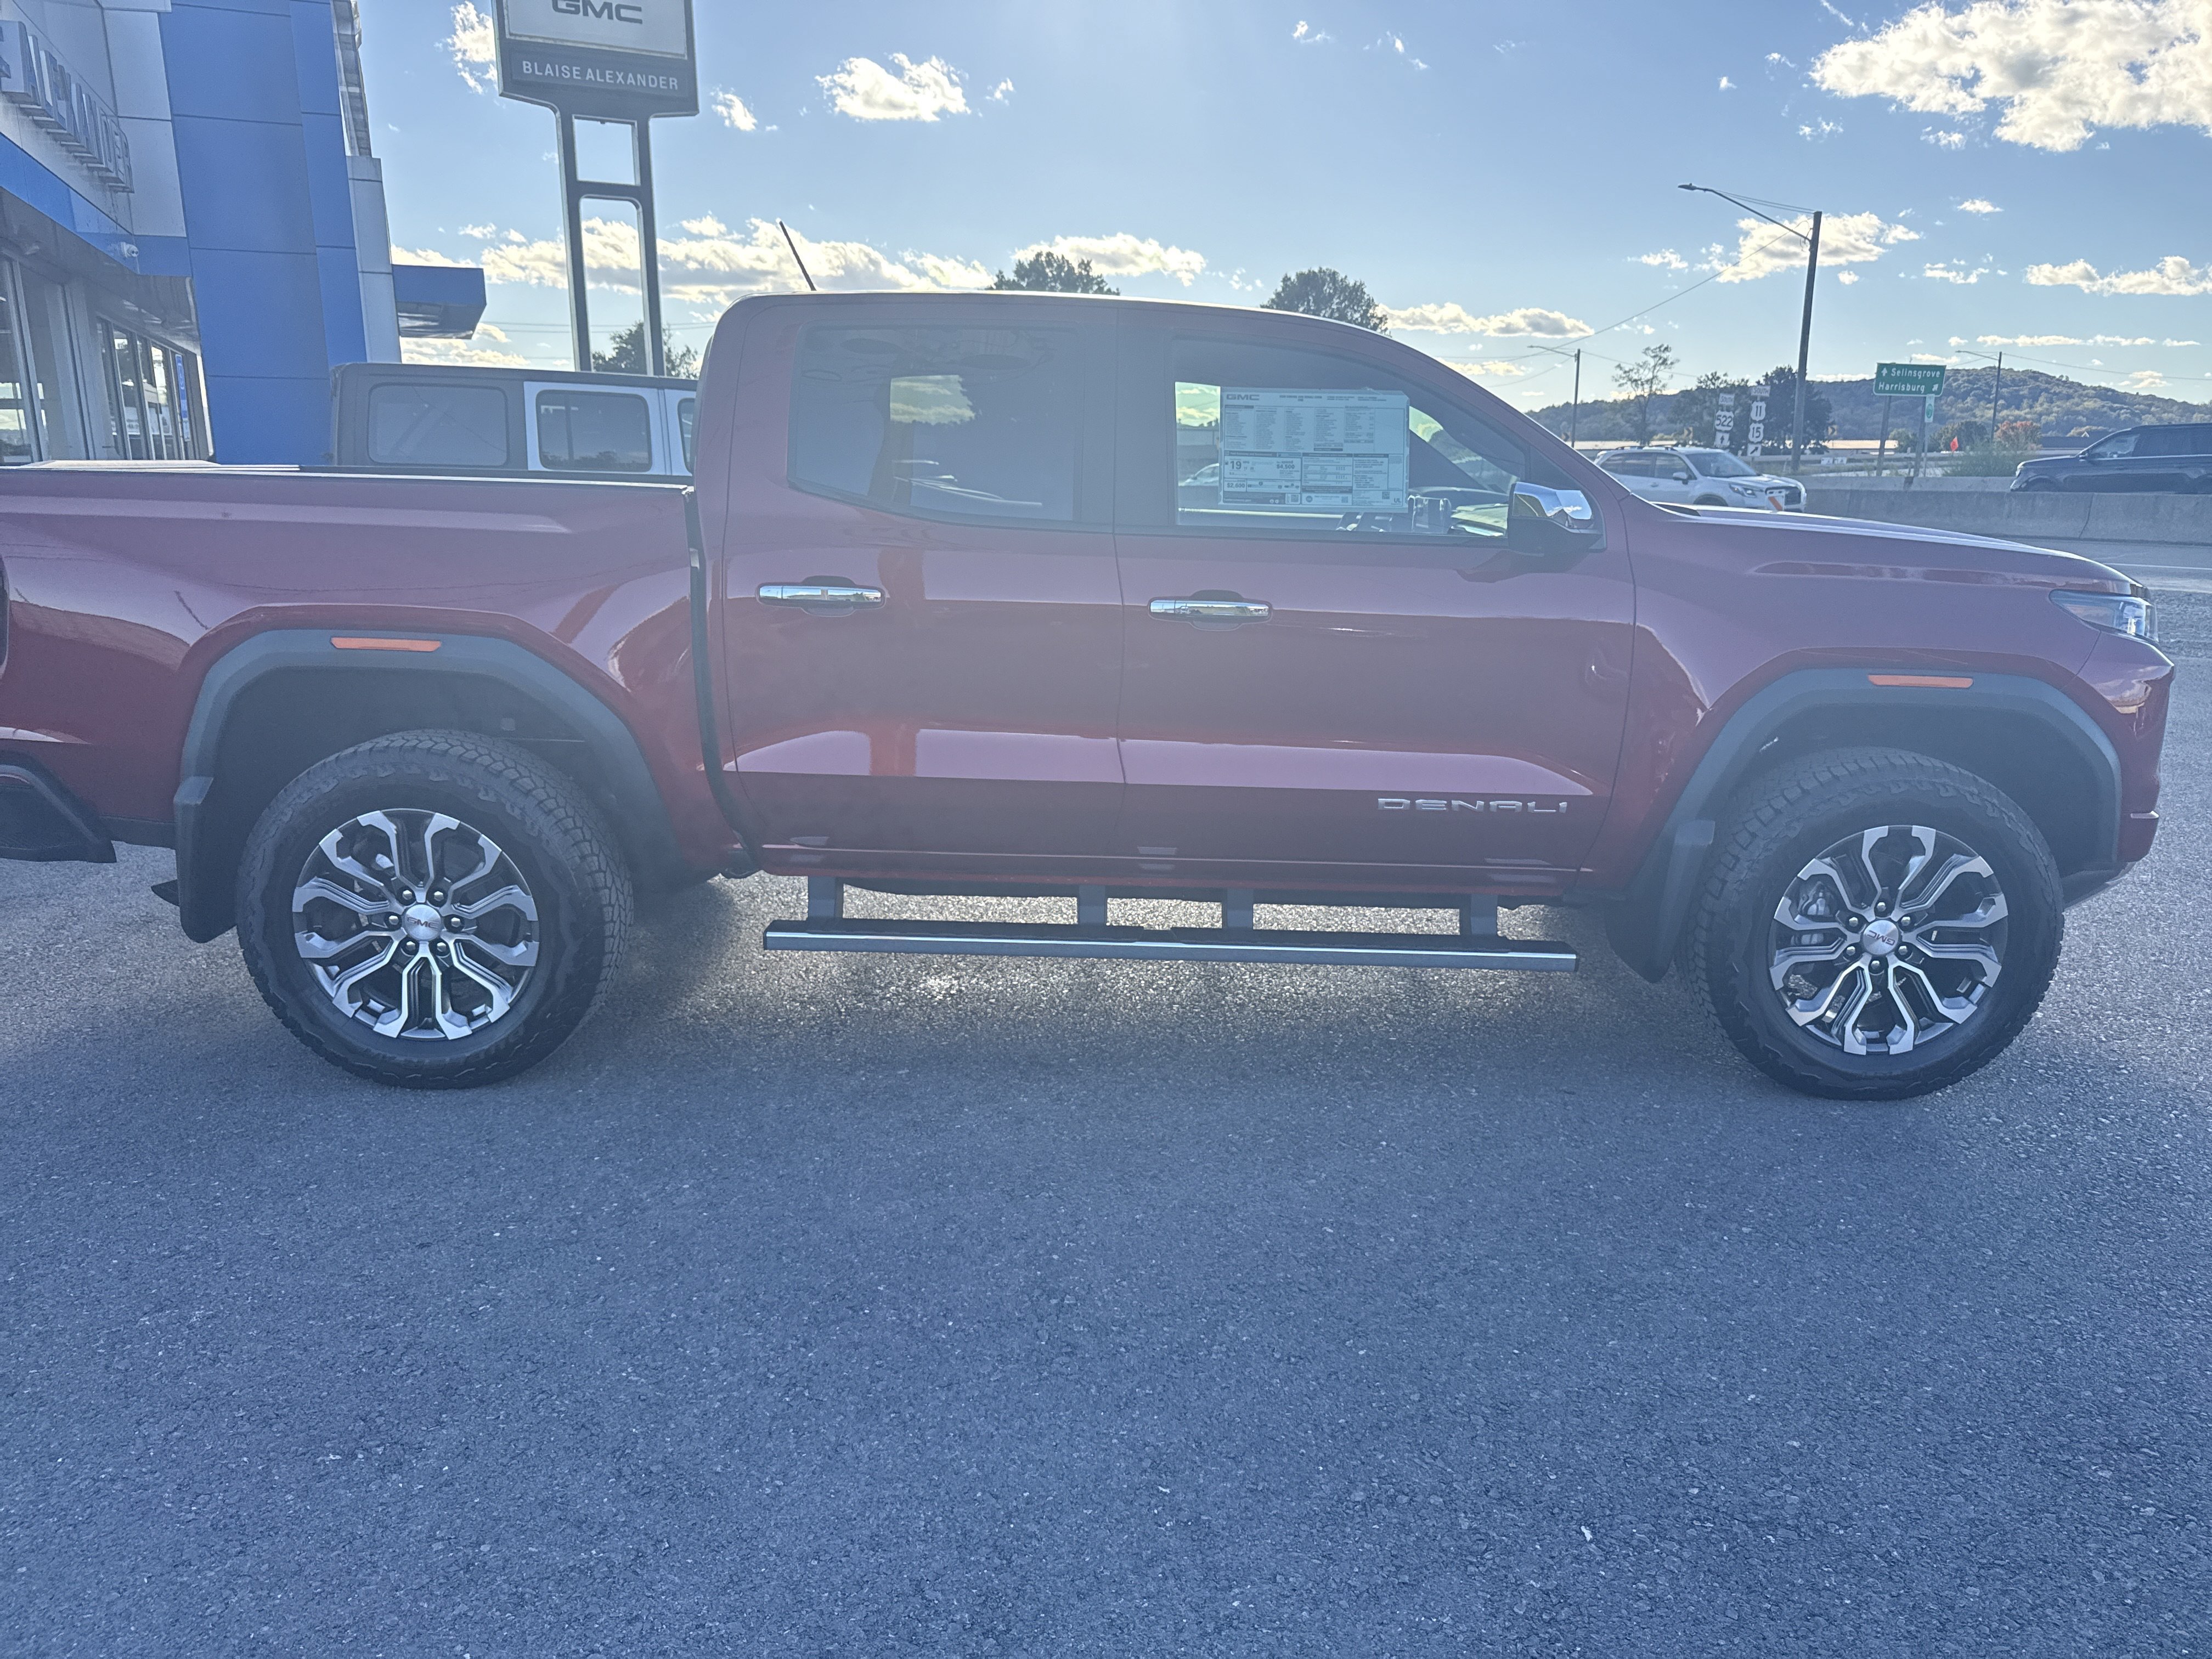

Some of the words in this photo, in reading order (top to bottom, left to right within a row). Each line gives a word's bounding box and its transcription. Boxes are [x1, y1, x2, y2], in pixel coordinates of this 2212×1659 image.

[551, 0, 643, 24] GMC
[522, 60, 581, 80] BLAISE
[585, 67, 679, 91] ALEXANDER
[1891, 367, 1940, 380] Selinsgrove
[1878, 381, 1926, 394] Harrisburg
[1756, 405, 1762, 417] 11
[1716, 414, 1733, 427] 522
[1752, 426, 1762, 438] 15
[1230, 460, 1242, 470] 19
[1378, 798, 1567, 814] DENALI
[407, 917, 439, 929] GMC
[1867, 930, 1895, 946] GMC
